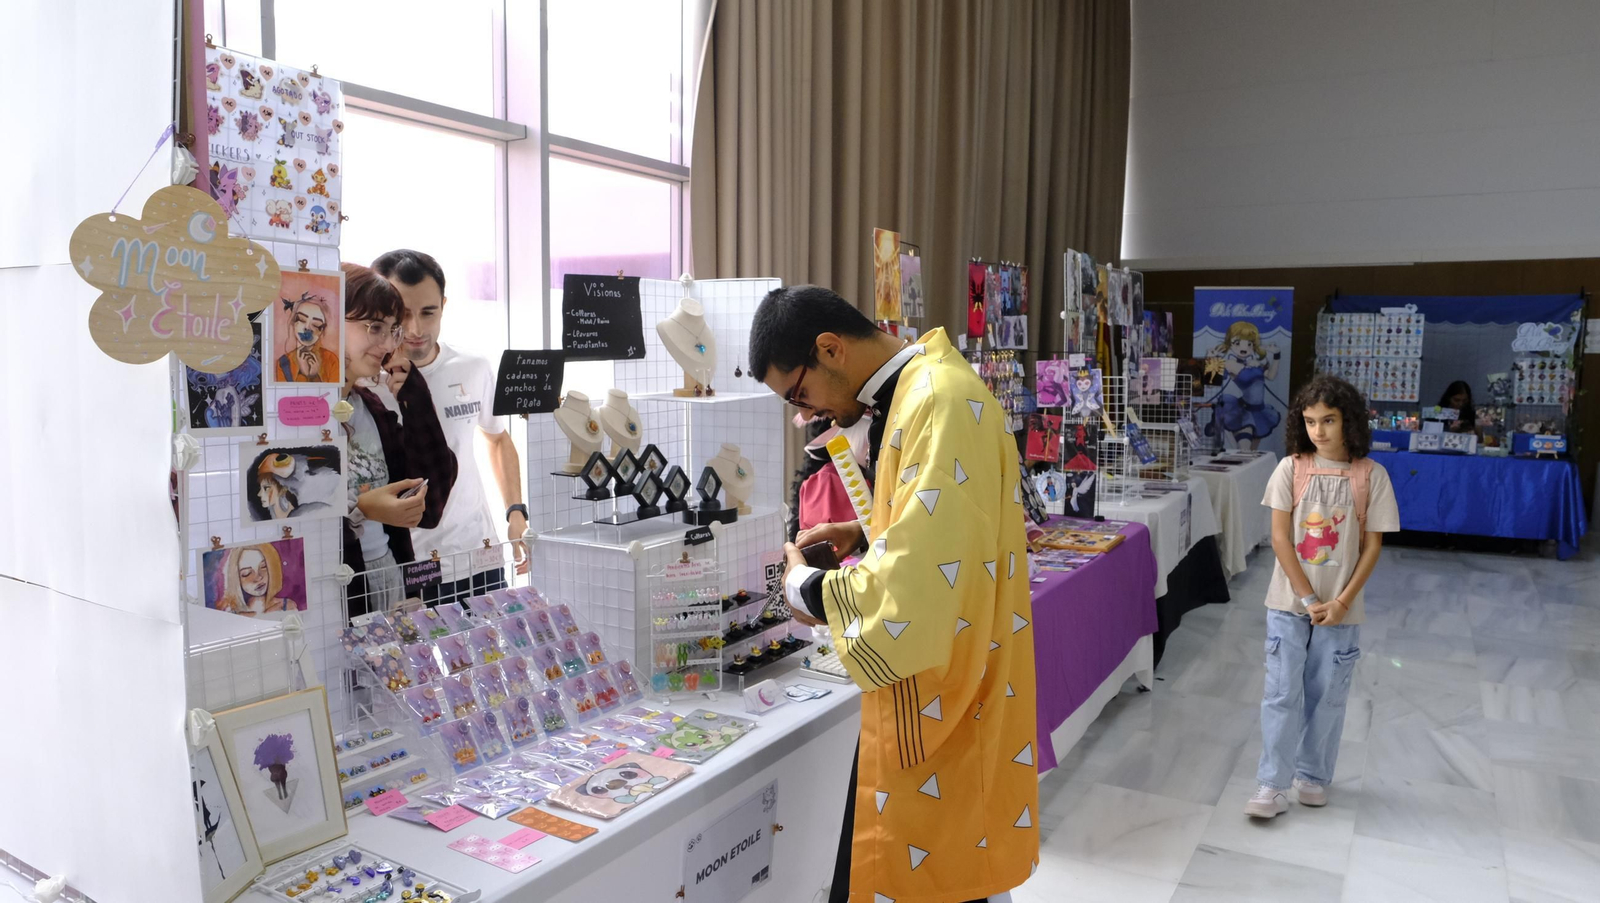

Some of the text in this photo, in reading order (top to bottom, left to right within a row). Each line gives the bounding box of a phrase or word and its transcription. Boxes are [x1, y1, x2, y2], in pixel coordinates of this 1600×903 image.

[272, 85, 303, 101] AGOTADO
[290, 129, 326, 144] OUT STOCK
[210, 143, 250, 161] ICKERS
[111, 237, 211, 296] Moon
[583, 282, 622, 298] Visiones
[150, 279, 232, 343] Etoile
[506, 371, 550, 381] cadenas y
[504, 383, 536, 395] ganchos
[695, 852, 728, 885] MOON
[729, 828, 761, 860] ETOILE
